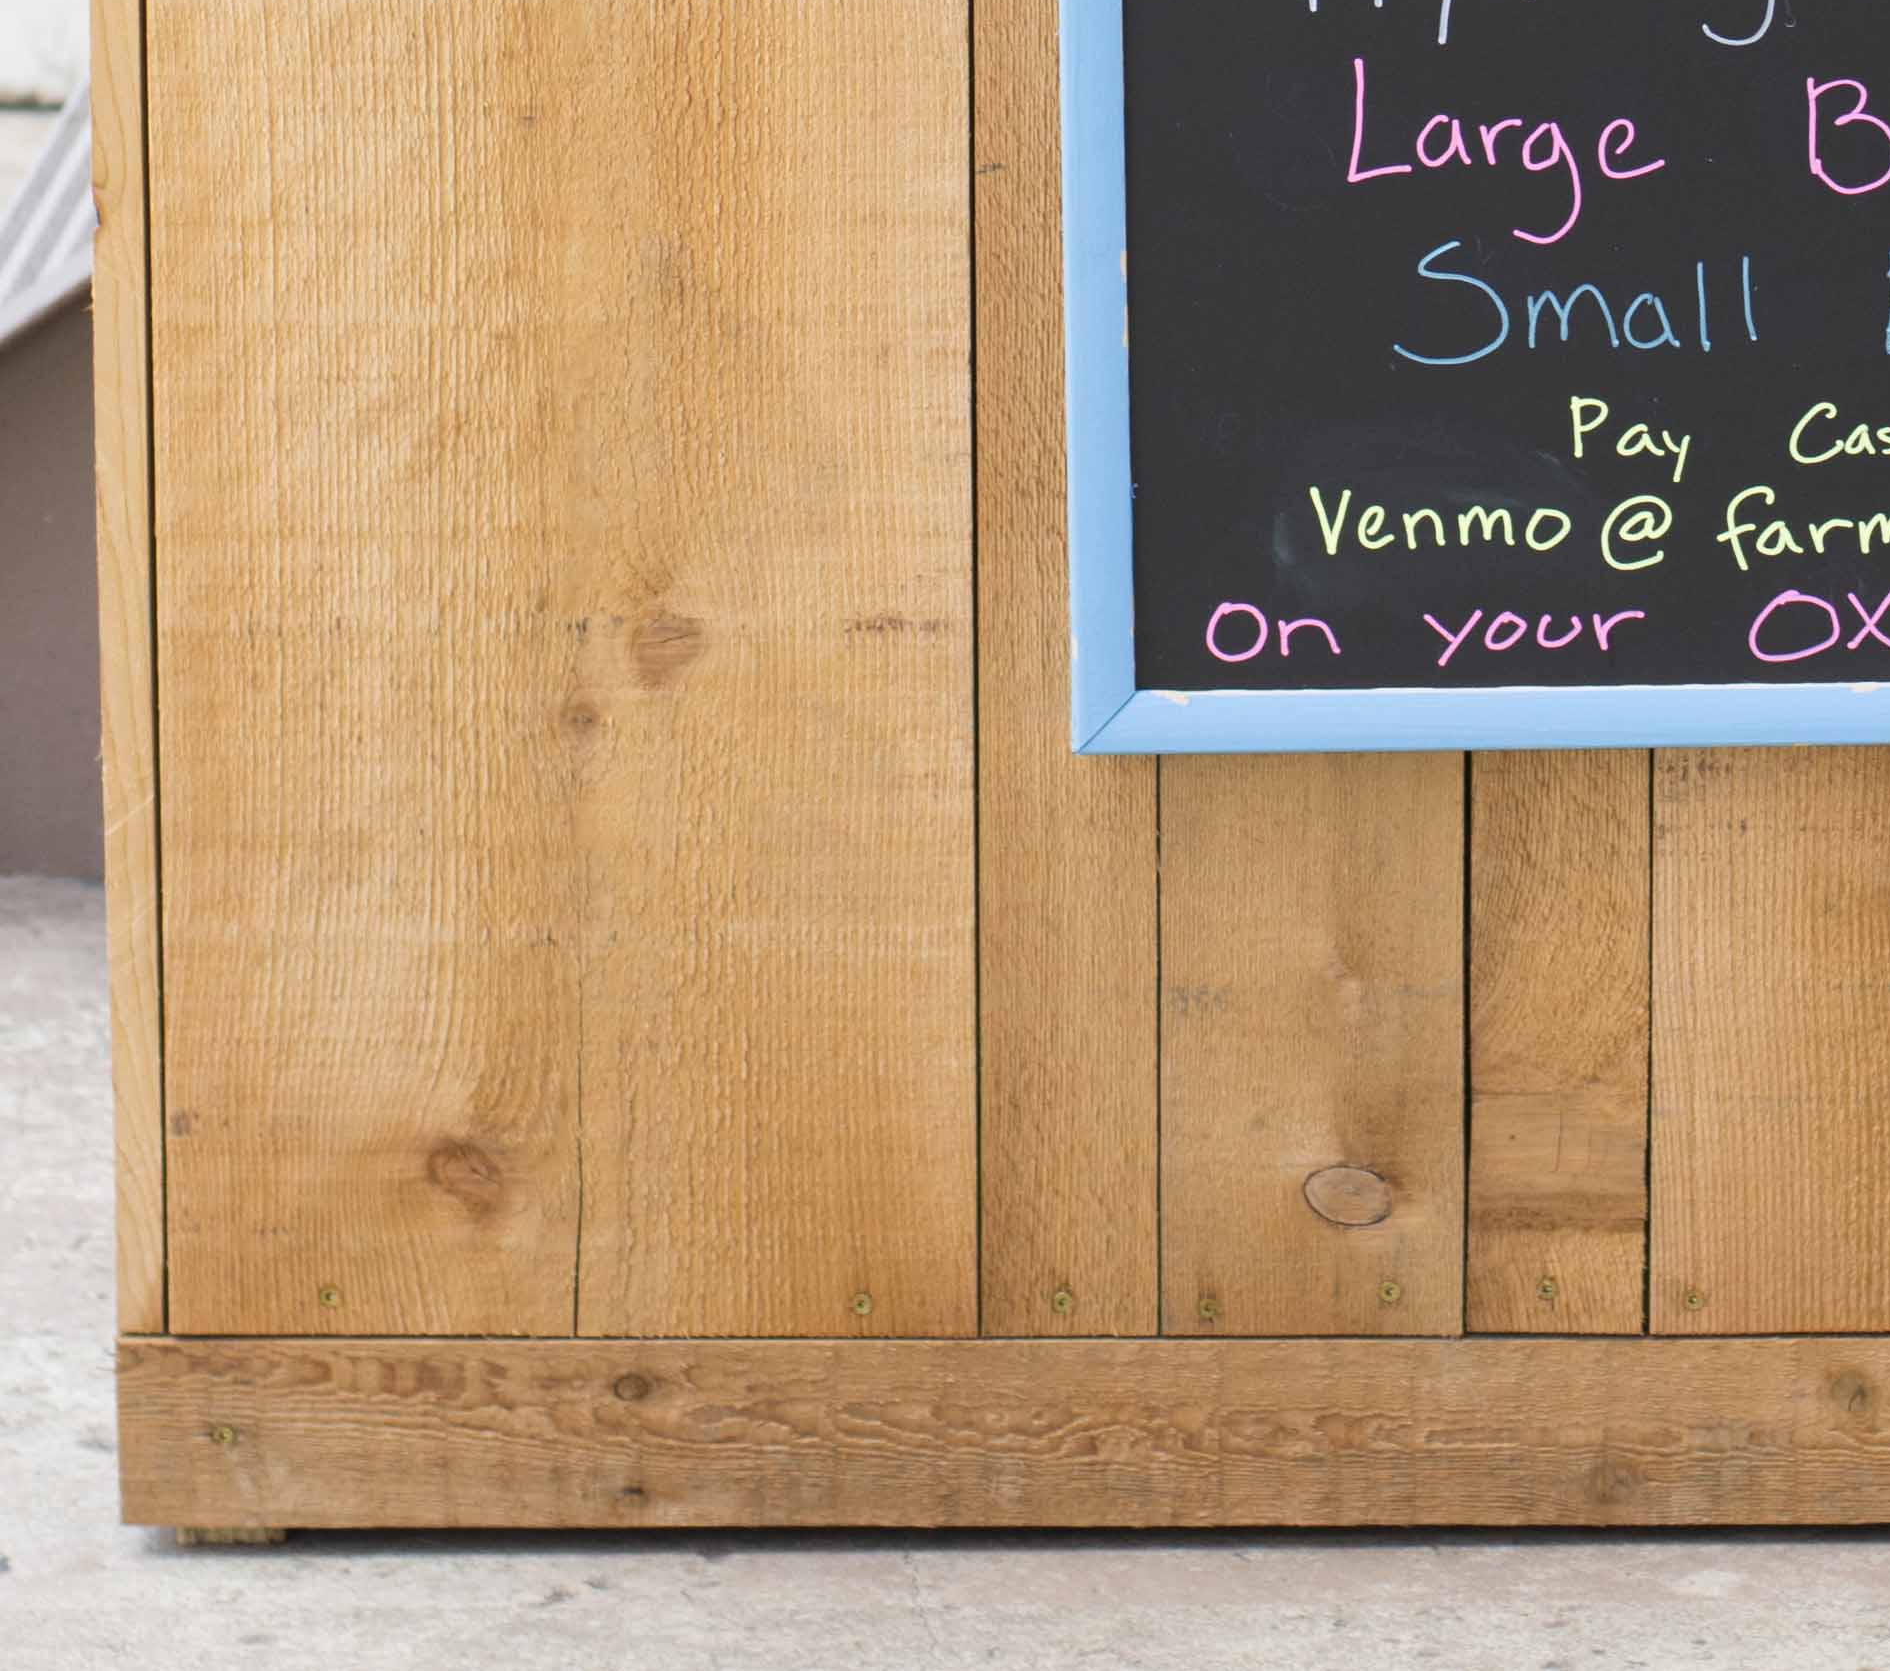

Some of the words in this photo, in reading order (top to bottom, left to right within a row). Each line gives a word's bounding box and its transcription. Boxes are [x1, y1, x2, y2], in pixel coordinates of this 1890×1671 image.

[1347, 58, 1665, 243] Large
[1394, 239, 1757, 364] Small
[1570, 396, 1690, 482] Pay
[1310, 486, 1571, 555] Venmo
[1206, 602, 1341, 662] On
[1423, 609, 1645, 666] your
